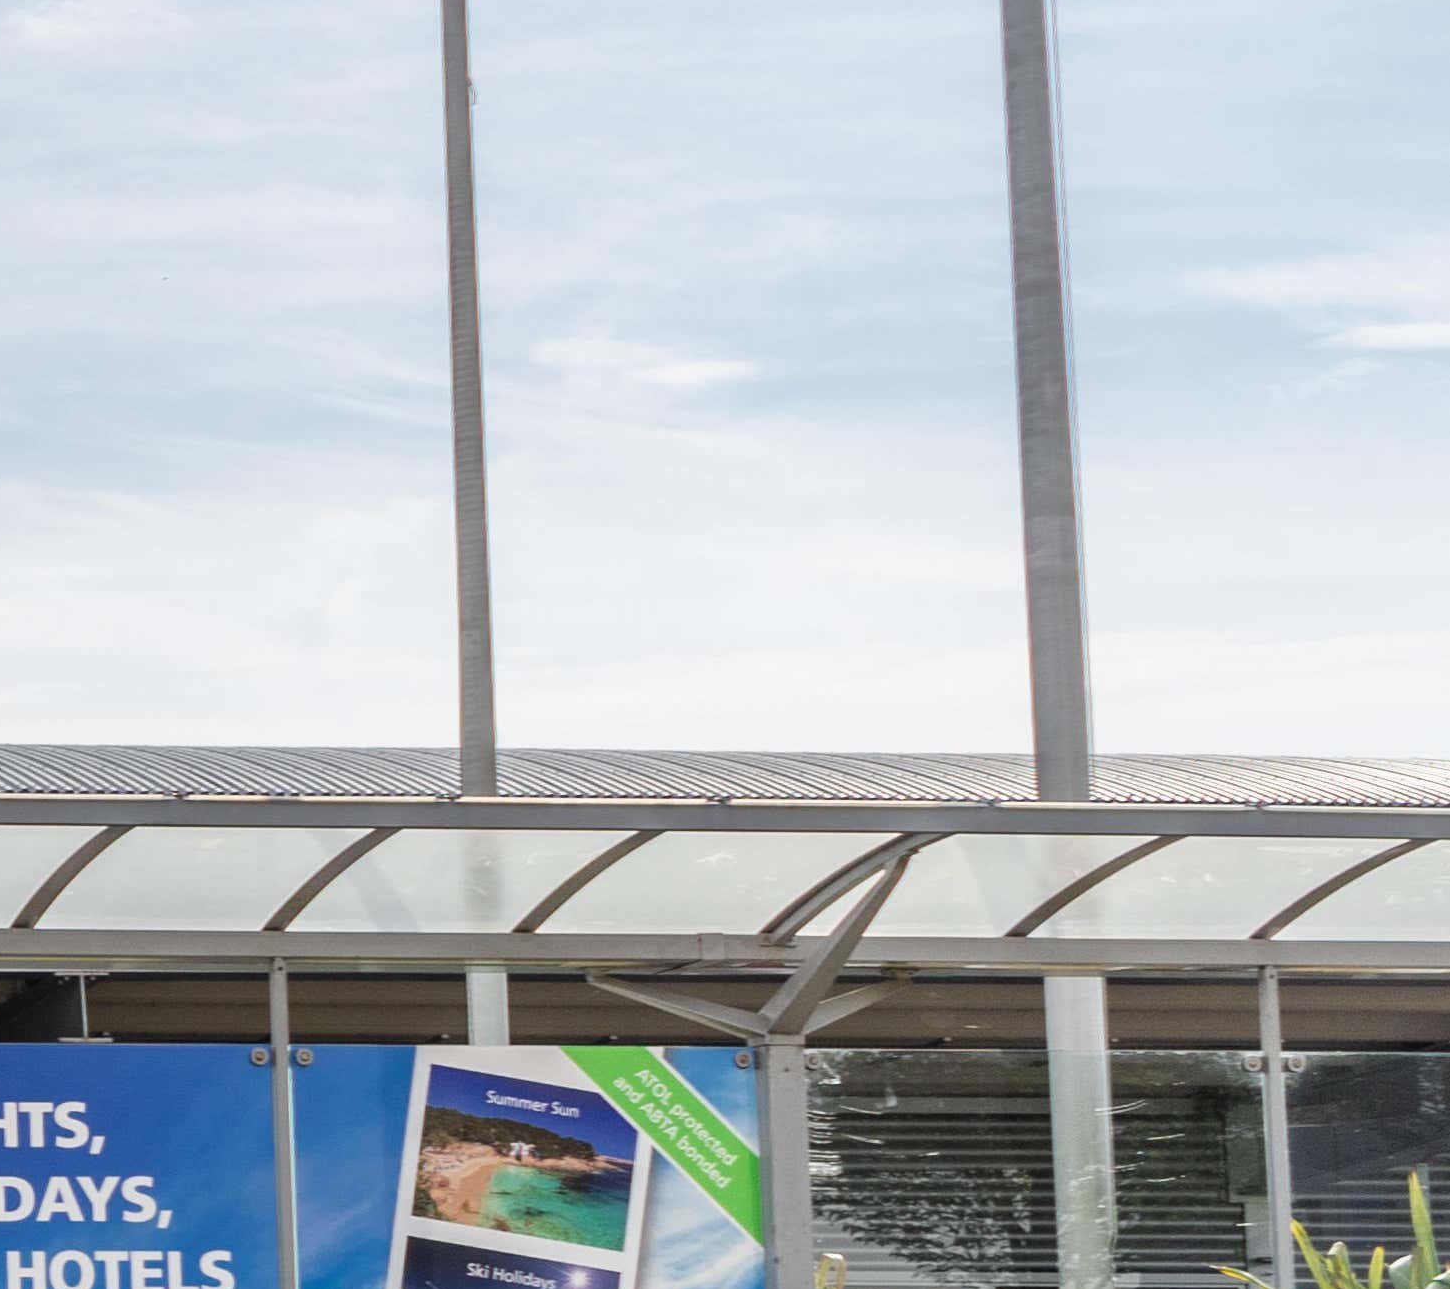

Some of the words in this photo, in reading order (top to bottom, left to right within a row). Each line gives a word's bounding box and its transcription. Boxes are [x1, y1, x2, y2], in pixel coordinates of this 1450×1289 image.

[485, 1090, 549, 1112] Summer
[550, 1101, 580, 1118] Sun
[612, 1076, 645, 1105] and
[639, 1101, 678, 1140] ABTA
[676, 1133, 731, 1189] bonded
[634, 1068, 673, 1107] ATOL
[671, 1104, 738, 1167] protected
[466, 1262, 490, 1279] Ski
